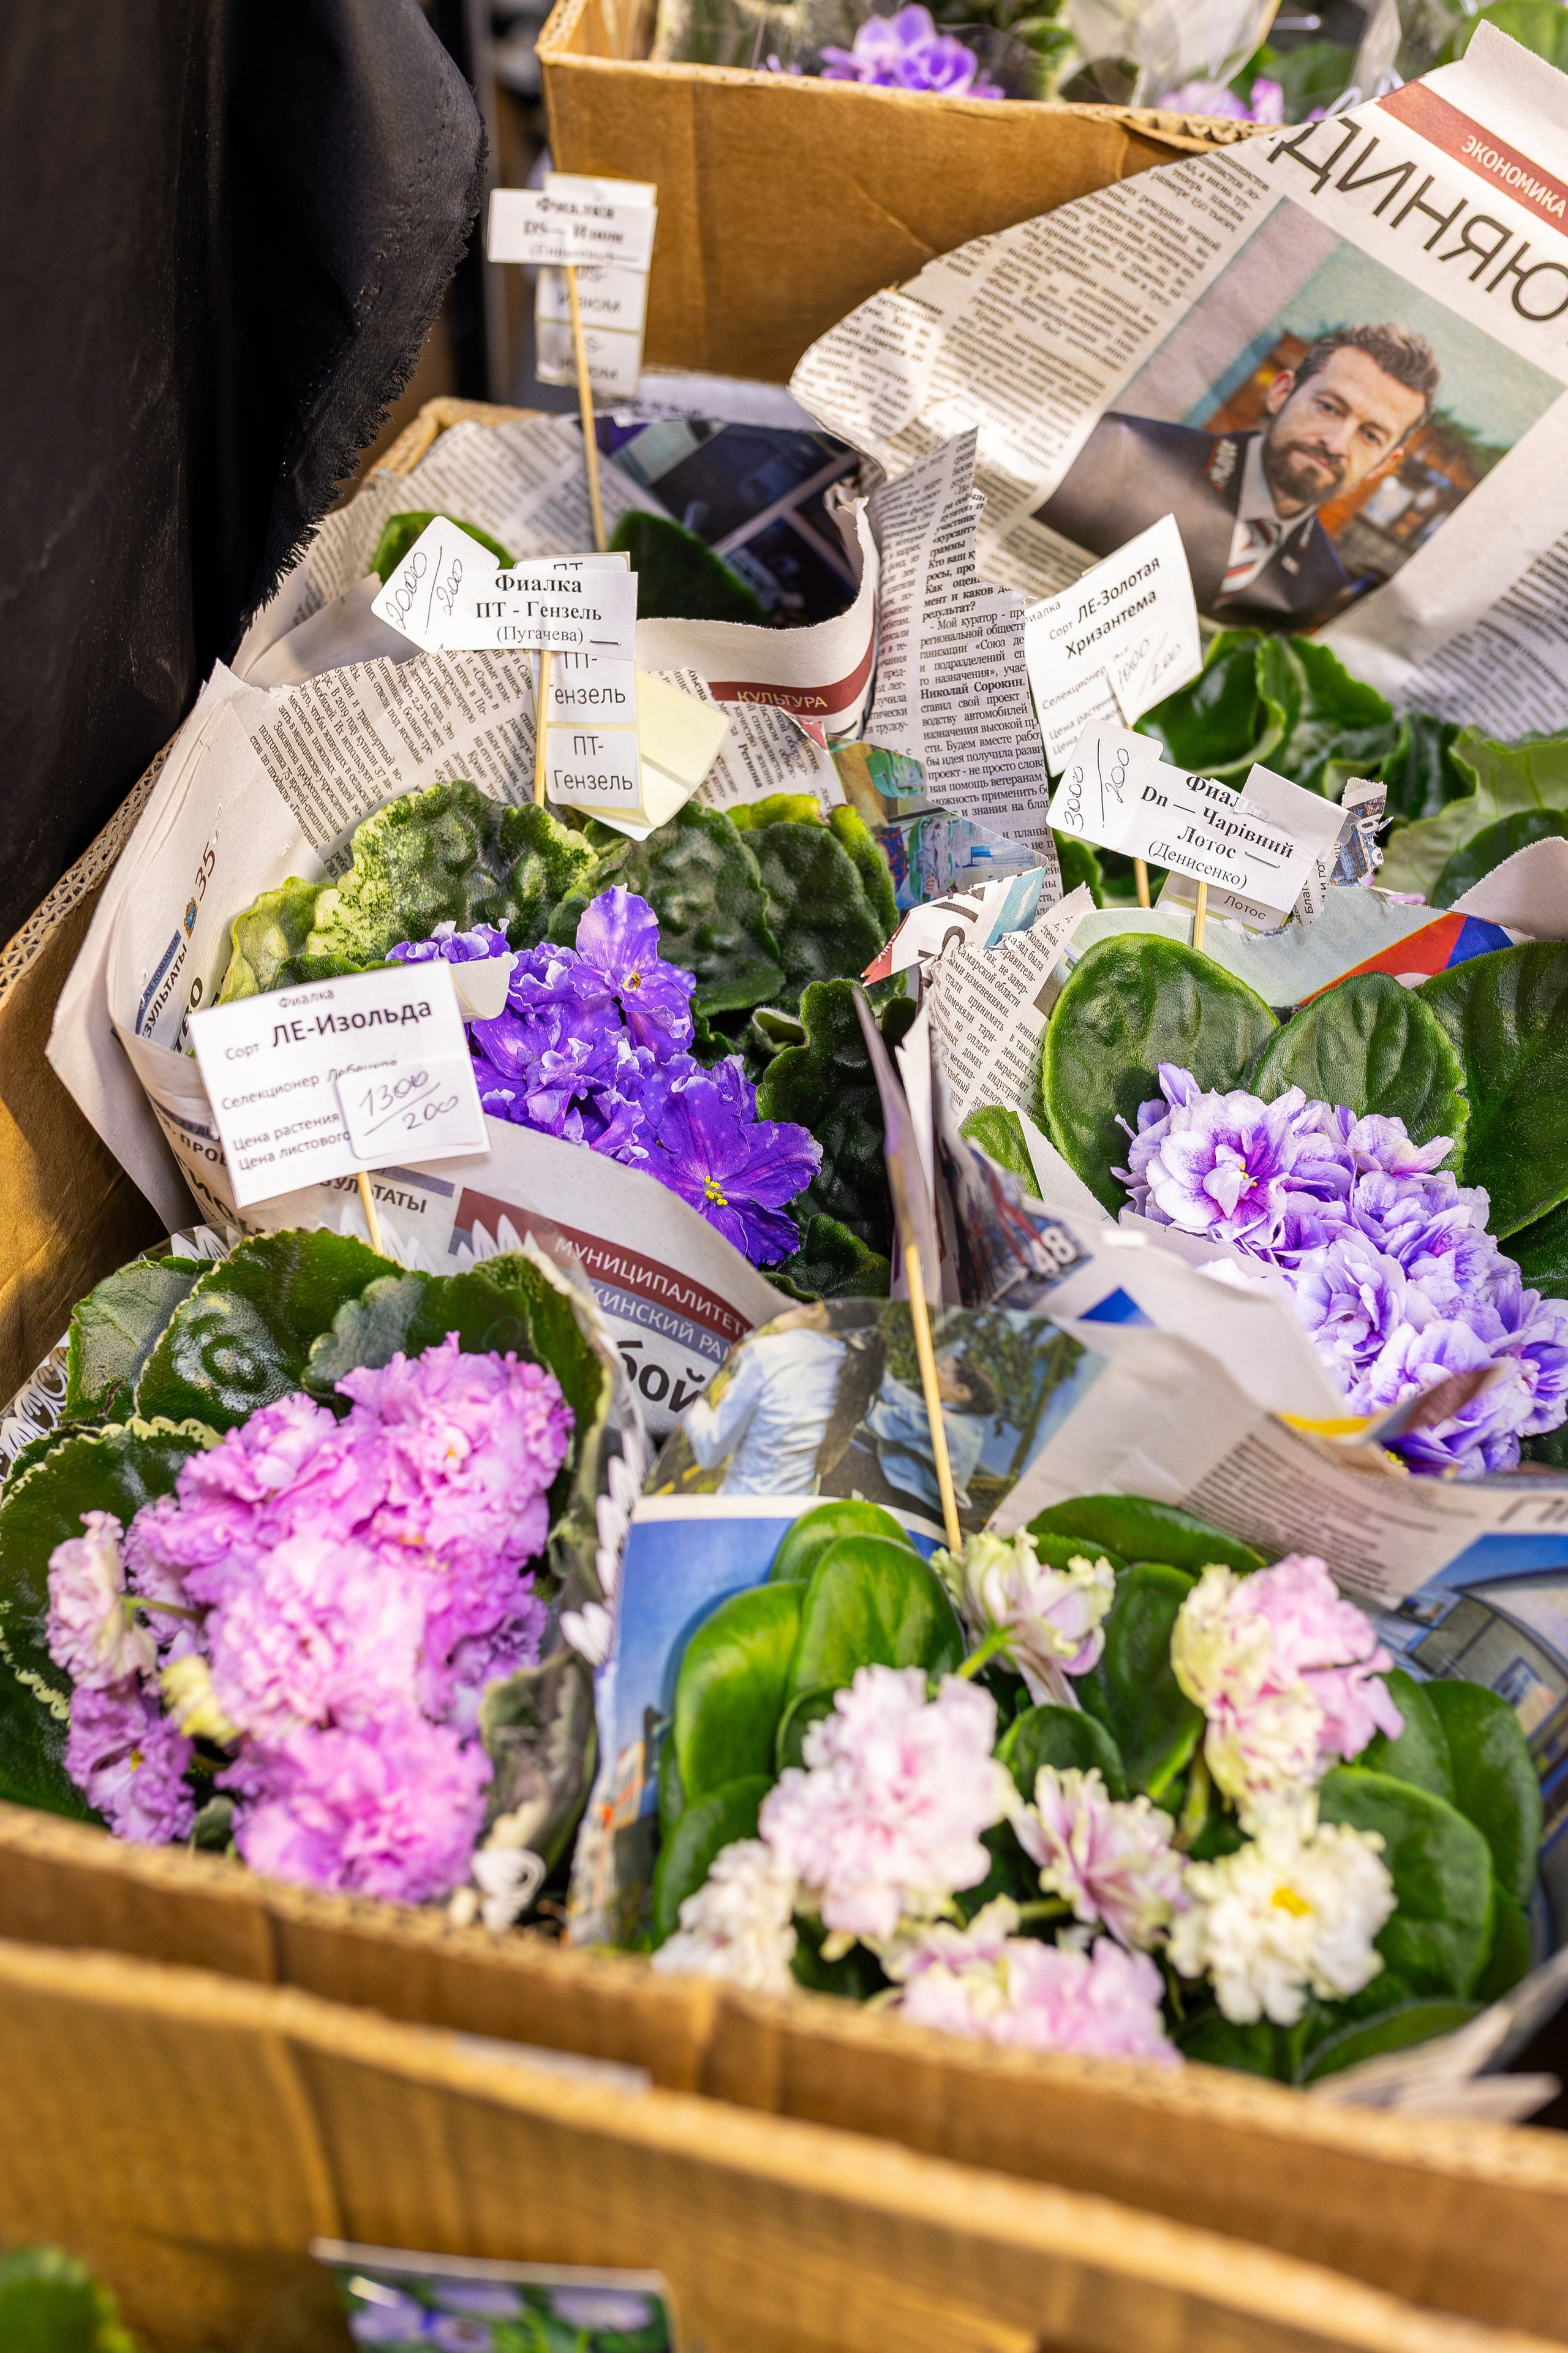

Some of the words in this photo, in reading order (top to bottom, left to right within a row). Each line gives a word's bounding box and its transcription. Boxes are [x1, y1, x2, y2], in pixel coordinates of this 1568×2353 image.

[1461, 135, 1567, 219] ЭКОНОМИКА
[537, 197, 614, 219] Фиалка
[495, 575, 582, 594] Фиалка
[1049, 621, 1073, 640] Сорт
[1077, 557, 1161, 624] ЛЕ-Золотая
[476, 602, 505, 619] ПТ
[527, 602, 601, 621] Гензель
[923, 601, 975, 622] результат?
[938, 618, 957, 630] Мой
[962, 613, 997, 627] куратор
[1066, 591, 1156, 659] Хризантема
[497, 627, 583, 644] (Пугачева)
[921, 626, 982, 649] региональной
[921, 644, 968, 659] ганизации
[976, 640, 1005, 649] «Союз
[935, 650, 1005, 670] подразделений
[921, 683, 968, 699] Николай
[974, 679, 1025, 693] Сорокин.
[935, 670, 998, 684] назначения»,
[1042, 666, 1106, 710] Селекционер
[409, 668, 432, 701] детских
[431, 702, 443, 723] сада.
[443, 722, 454, 739] Это
[549, 684, 626, 705] ензель
[921, 702, 952, 713] ставил
[959, 695, 979, 708] свой
[987, 693, 1019, 706] проект
[374, 682, 390, 709] отвели
[388, 709, 401, 728] под
[398, 727, 423, 765] ясельные
[412, 697, 423, 712] 2,2
[421, 711, 432, 730] тыс.
[431, 728, 444, 747] мест
[734, 706, 757, 747] качество
[922, 716, 957, 726] водству
[965, 703, 1028, 721] автомобилей
[924, 727, 979, 739] назначения
[981, 718, 1023, 733] высокой
[1049, 722, 1074, 740] Цена
[331, 687, 339, 697] В
[335, 697, 349, 717] 2019
[346, 717, 359, 735] году
[356, 735, 378, 766] купили
[375, 766, 386, 777] 37
[383, 778, 392, 790] ав-
[357, 709, 395, 766] транспортный
[393, 768, 402, 780] во-
[574, 736, 603, 756] ПТ-
[946, 741, 976, 752] Будем
[979, 736, 1012, 746] вместе
[1052, 736, 1078, 755] Цена
[251, 736, 263, 754] стов
[261, 753, 270, 766] по
[268, 766, 290, 803] профилю
[279, 705, 291, 724] зить
[292, 728, 321, 777] медицинские
[319, 775, 350, 825] учреждения.
[288, 695, 314, 736] местности
[312, 736, 336, 775] пожилых
[334, 776, 356, 803] людей
[352, 804, 367, 818] во-
[311, 705, 326, 731] чтобы
[323, 730, 347, 768] живущих
[349, 774, 375, 810] сельской
[334, 720, 344, 736] Их
[342, 736, 374, 783] используют
[371, 784, 383, 802] для
[738, 744, 762, 788] Региона
[926, 757, 940, 766] бы
[942, 755, 964, 765] идея
[967, 750, 1013, 762] получила
[929, 769, 960, 782] проект
[982, 763, 1016, 776] просто
[259, 724, 287, 769] подготовка
[282, 767, 292, 780] 75
[289, 777, 330, 842] врачей-специали-
[274, 721, 299, 765] Закончена
[297, 764, 343, 836] профессиональная
[554, 770, 633, 790] Гензель
[949, 780, 989, 791] помощь
[990, 774, 1042, 787] ветеранам
[1141, 785, 1168, 807] Dn
[1203, 806, 1294, 859] Чарівний
[1177, 826, 1236, 859] Лотос
[195, 841, 215, 902] 35
[1148, 840, 1247, 889] (Денисенко)
[1224, 895, 1266, 920] Лотос
[1028, 951, 1044, 972] была
[278, 988, 335, 1009] Фиалка
[946, 973, 963, 993] стали
[968, 995, 1003, 1031] принимать
[964, 972, 1009, 1018] изменениями.
[995, 981, 1020, 1007] области
[225, 1043, 260, 1060] Сорт
[271, 1000, 432, 1047] ЛЕ-Изольда
[944, 988, 974, 1024] Поменяли
[979, 1024, 996, 1041] тари-
[955, 1021, 963, 1032] по
[967, 1033, 990, 1056] оплате
[1016, 1022, 1041, 1047] ленных
[950, 1052, 974, 1079] механиз-
[962, 1048, 982, 1069] домах
[1001, 1047, 1028, 1073] леньких
[1016, 1040, 1036, 1063] таком
[987, 1071, 1026, 1106] индустрии.
[995, 1059, 1031, 1092] вырастают
[221, 1075, 320, 1111] Селекционер
[359, 1070, 429, 1116] 1300
[402, 1095, 458, 1130] 200
[233, 1131, 271, 1152] Цена
[274, 1112, 340, 1140] растения
[237, 1152, 276, 1172] Цена
[279, 1131, 351, 1160] листового
